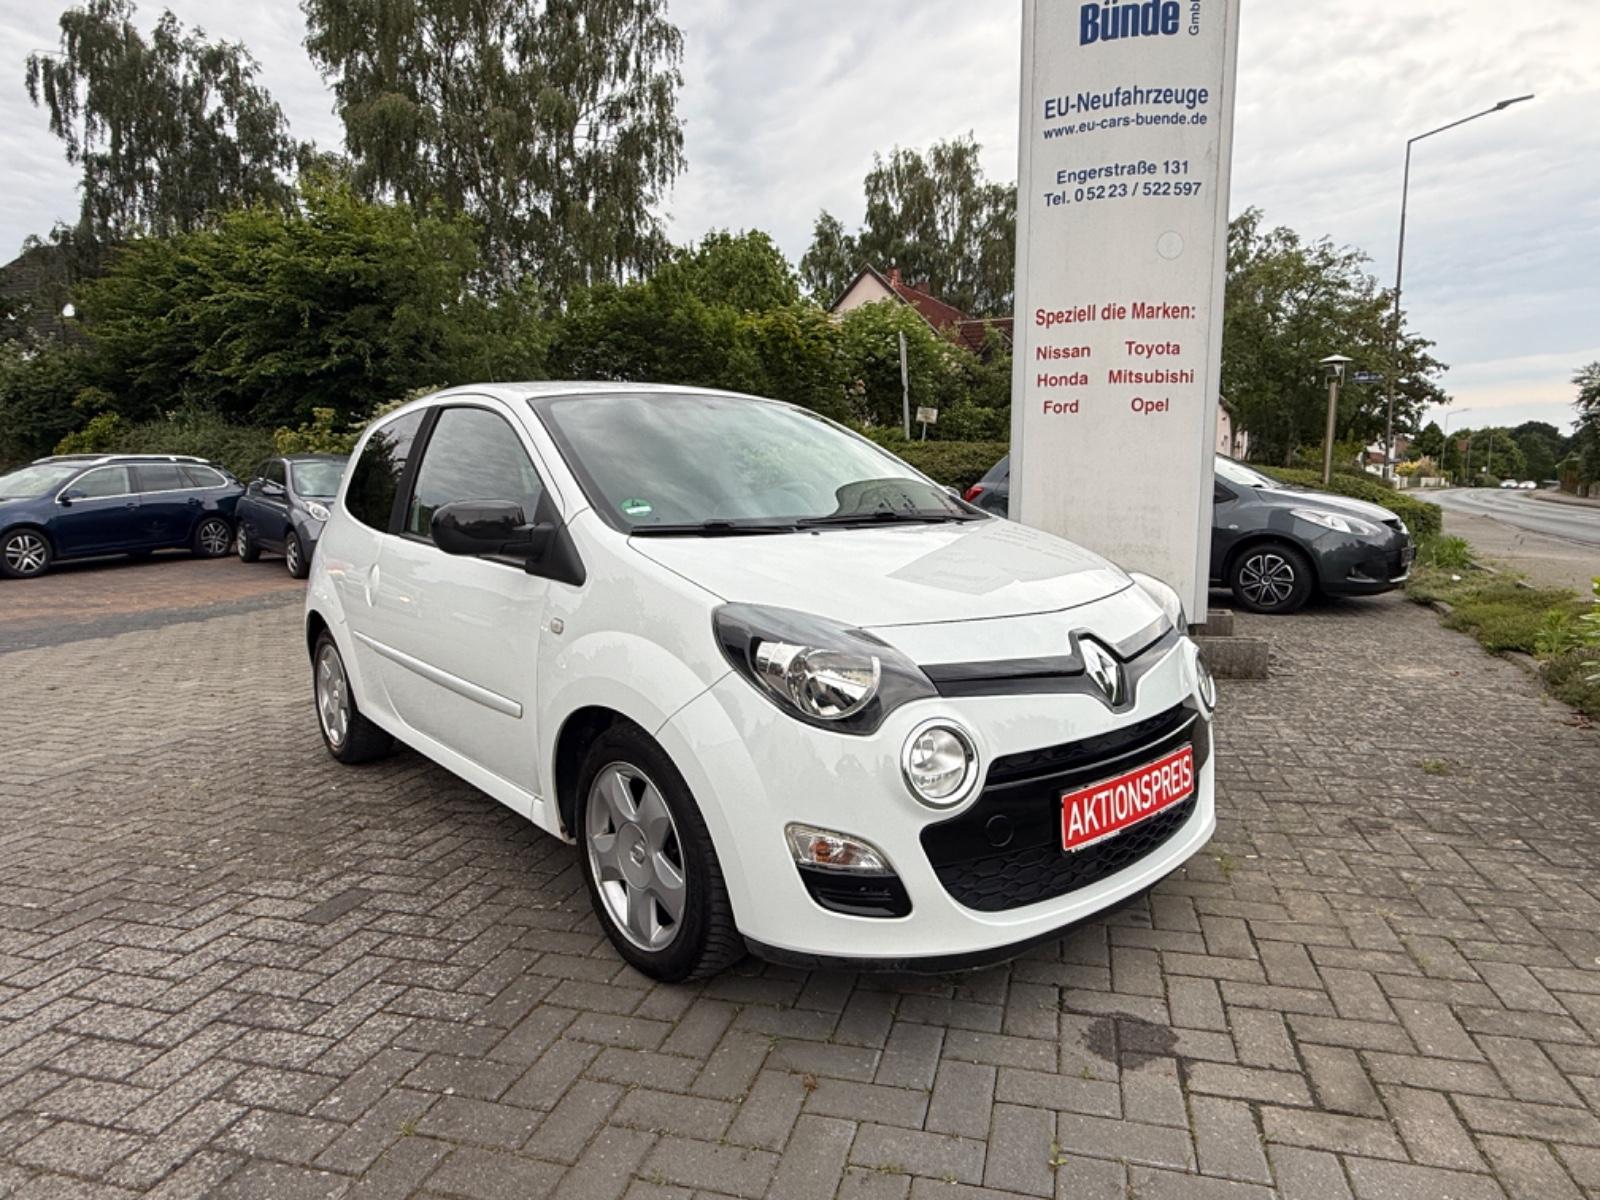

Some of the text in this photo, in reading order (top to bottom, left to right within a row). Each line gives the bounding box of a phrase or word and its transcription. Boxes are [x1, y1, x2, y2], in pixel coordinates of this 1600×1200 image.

[1079, 0, 1180, 46] Bünde
[1188, 0, 1200, 36] Gmb
[1044, 85, 1209, 119] EU-Neufahrzeuge
[1043, 112, 1208, 139] www.eu-cars-buende.de
[1056, 160, 1189, 185] Engerstraße 131
[1044, 191, 1071, 207] Tel.
[1035, 302, 1196, 328] Speziell die Marken:
[1036, 345, 1091, 361] Nissan
[1125, 341, 1181, 359] Toyota
[1037, 372, 1089, 388] Honda
[1108, 369, 1195, 385] Mitsubishi
[1043, 400, 1079, 414] Ford
[1131, 397, 1169, 415] Opel
[1067, 755, 1193, 841] AKTIONSPREIS
